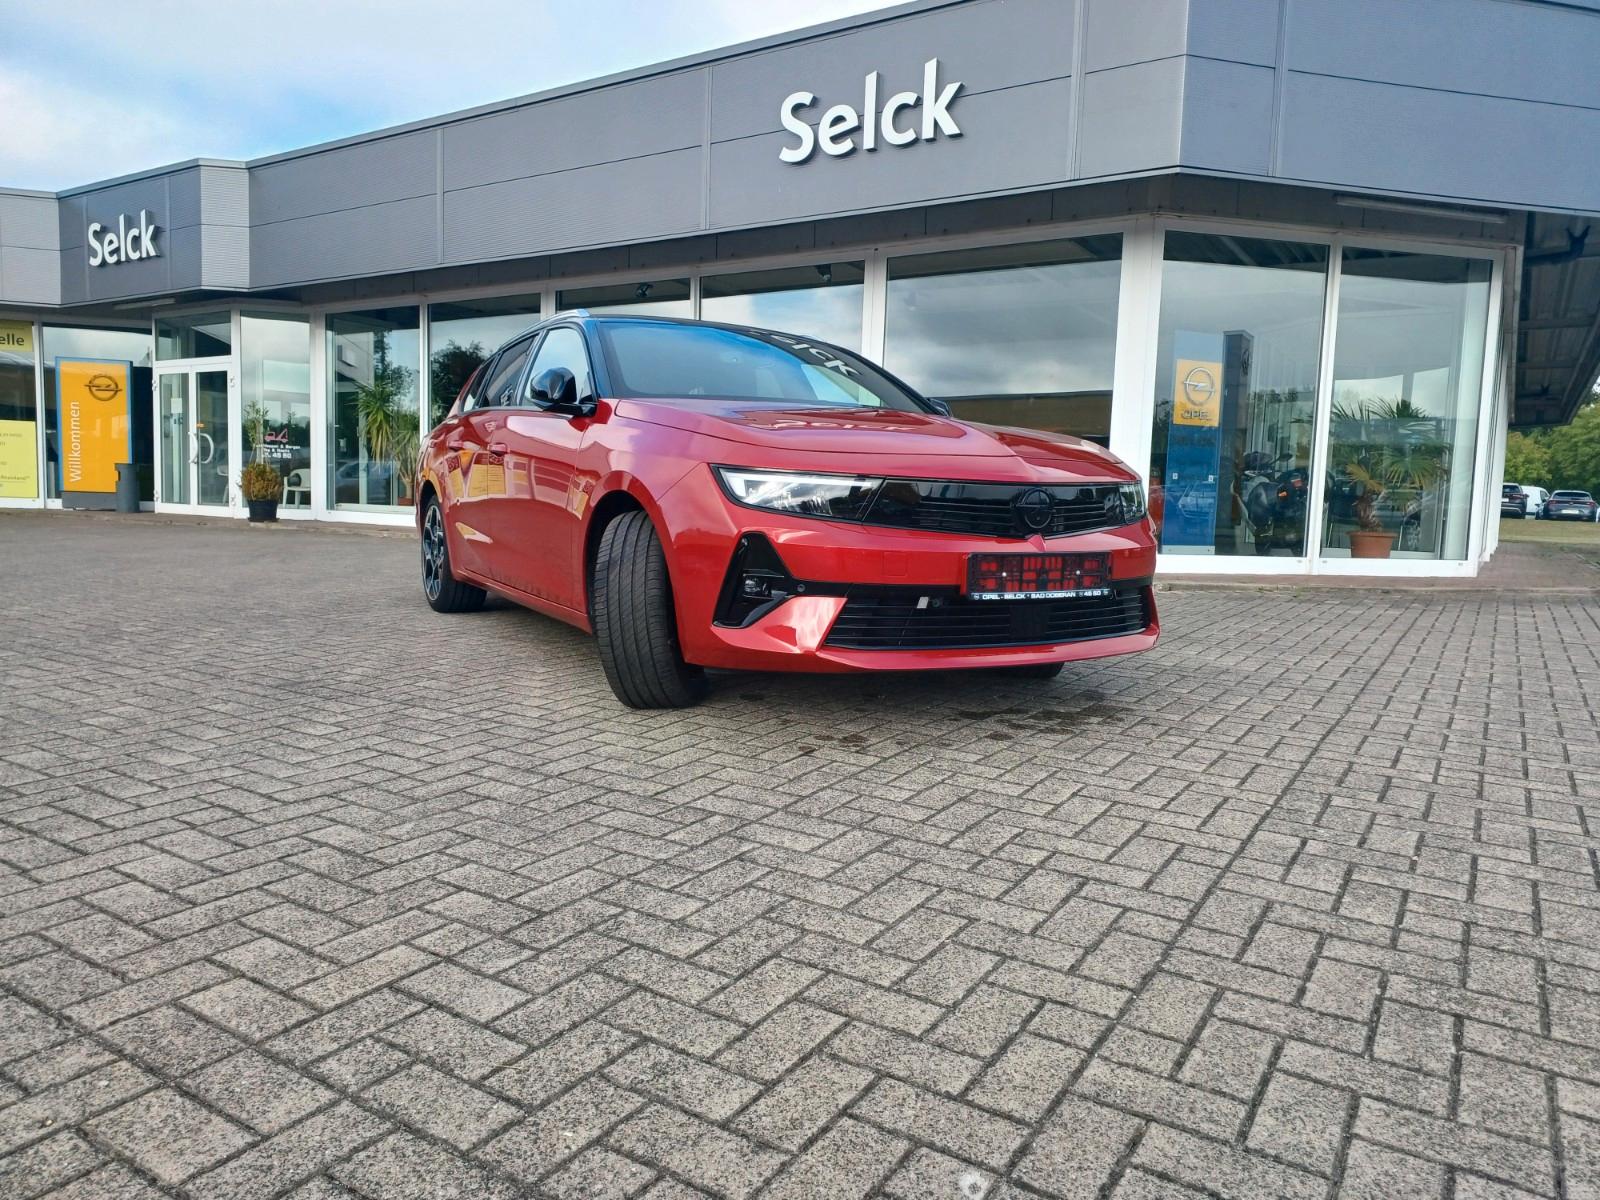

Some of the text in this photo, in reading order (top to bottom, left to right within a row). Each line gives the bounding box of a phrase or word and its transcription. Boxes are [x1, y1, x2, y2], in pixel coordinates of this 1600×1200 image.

[778, 57, 964, 164] Selck
[87, 209, 158, 267] Selck
[68, 401, 82, 483] Willkommen
